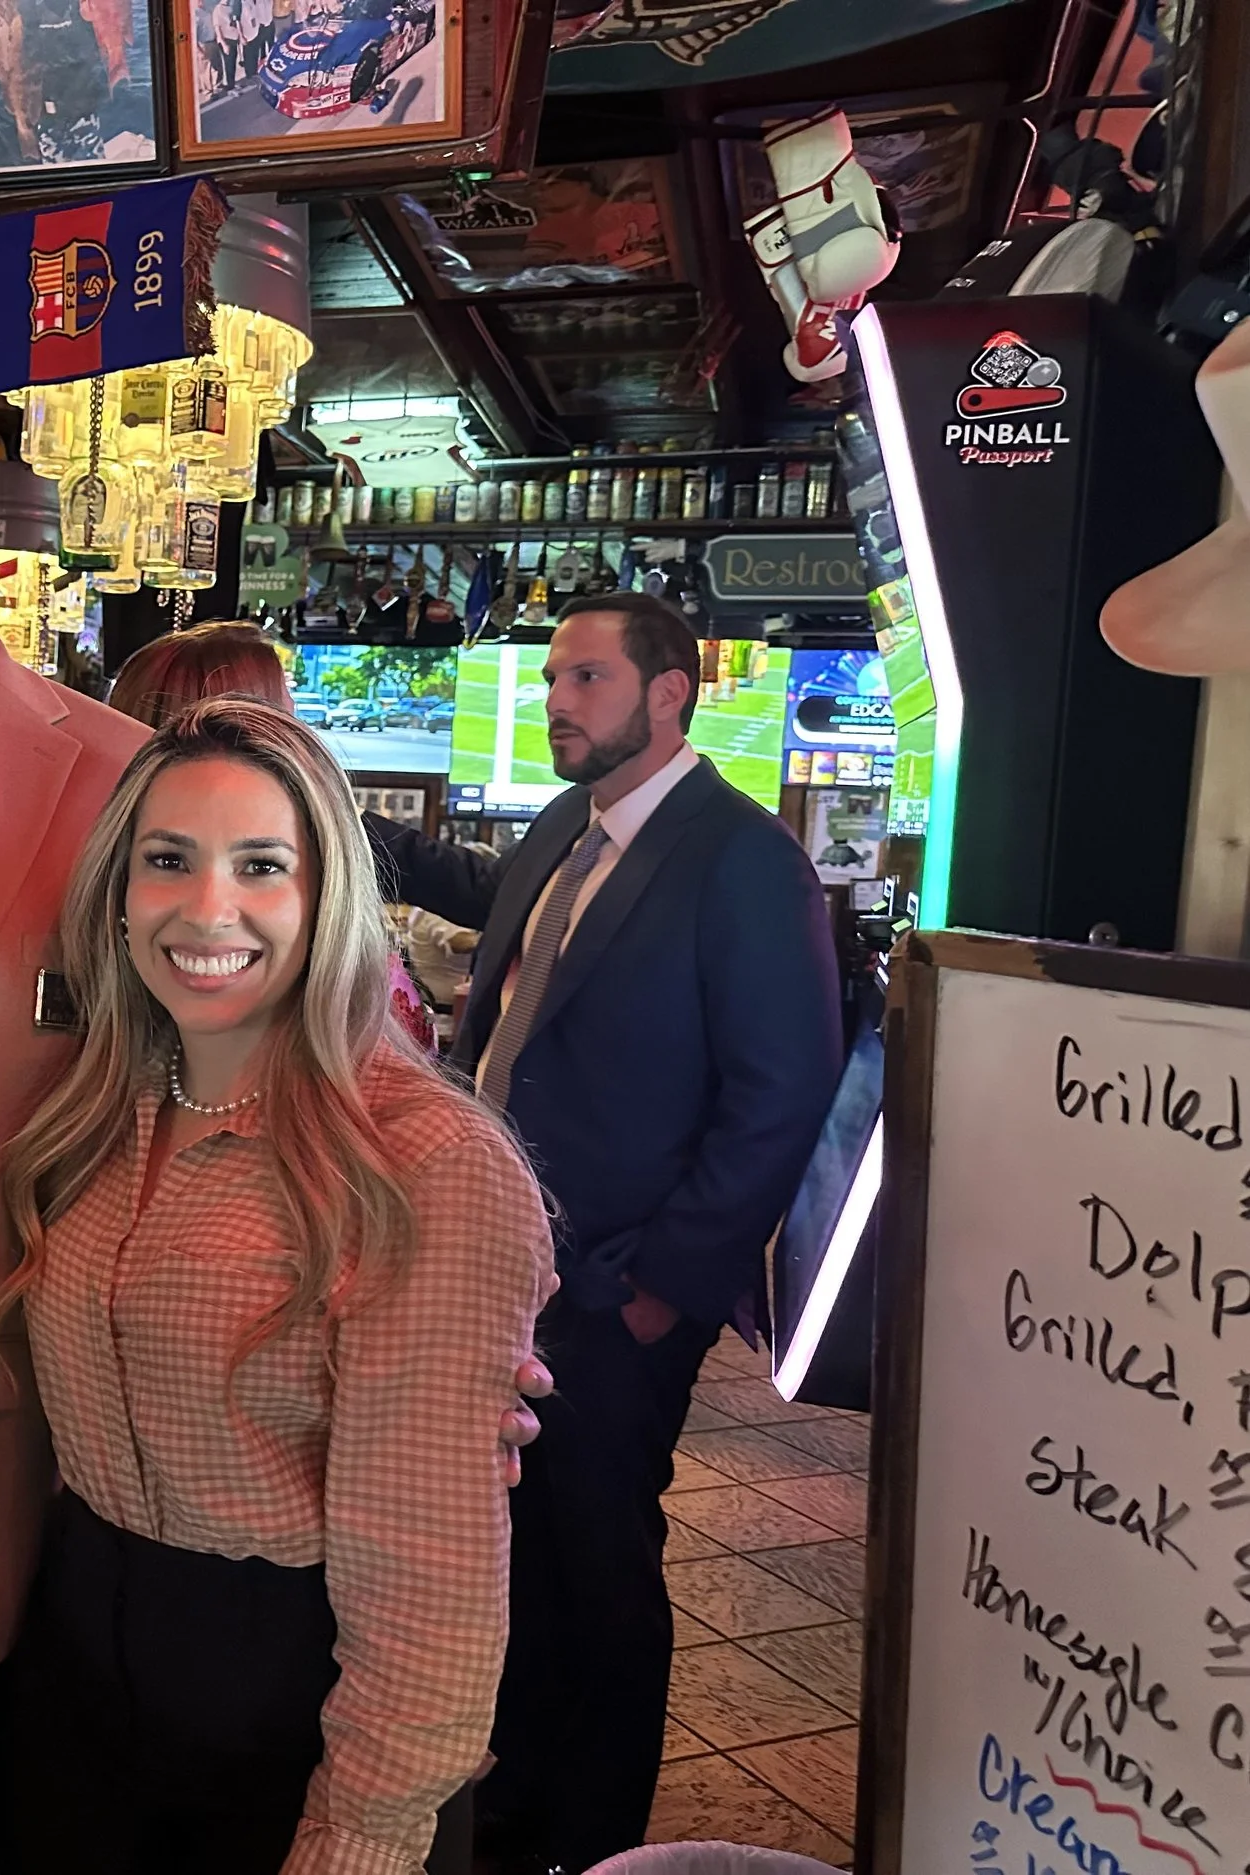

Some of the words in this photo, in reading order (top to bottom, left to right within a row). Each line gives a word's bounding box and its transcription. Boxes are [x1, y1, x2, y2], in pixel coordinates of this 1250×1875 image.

[439, 215, 531, 229] WIZARD
[65, 271, 76, 310] FCB
[134, 230, 164, 312] 1899
[945, 422, 1071, 446] PINBALL
[959, 446, 1054, 468] Passport
[1055, 1035, 1243, 1151] Grilled
[1005, 1268, 1193, 1426] Grilled,
[1025, 1436, 1199, 1572] Steak
